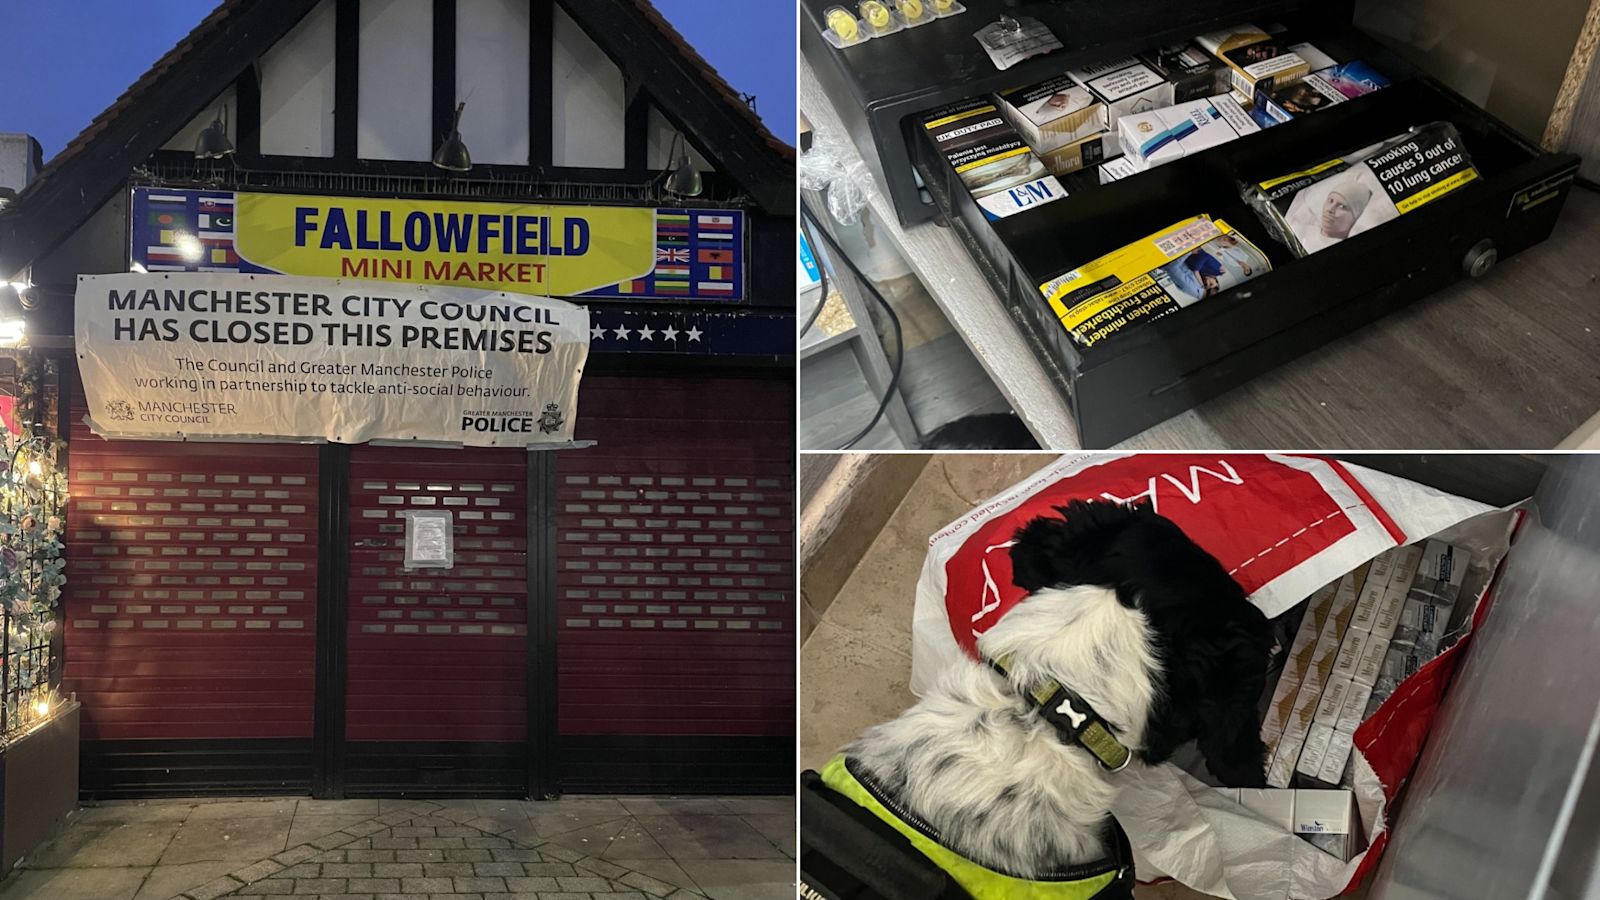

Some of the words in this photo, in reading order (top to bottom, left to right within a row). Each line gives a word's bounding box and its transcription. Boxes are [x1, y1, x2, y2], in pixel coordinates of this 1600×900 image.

[937, 133, 951, 142] UK
[954, 126, 978, 138] DUTY
[980, 118, 1002, 129] PAID
[948, 148, 974, 160] Palenie
[974, 144, 988, 154] jest
[1368, 141, 1420, 170] Smoking
[1379, 158, 1417, 182] causes
[1414, 152, 1425, 164] 9
[1424, 144, 1446, 160] out
[1442, 137, 1457, 152] of
[1008, 180, 1054, 208] L&M
[1387, 180, 1404, 196] 10
[1404, 169, 1433, 190] lung
[294, 207, 591, 257] FALLOWFIELD
[341, 257, 413, 280] MINI
[424, 260, 547, 284] MARKET
[1127, 292, 1172, 322] Rauchen
[1140, 284, 1163, 302] Ihre
[108, 289, 333, 316] MANCHESTER
[341, 296, 412, 319] CITY
[420, 301, 560, 326] COUNCIL
[114, 318, 180, 342] HAS
[189, 322, 314, 346] CLOSED
[322, 323, 392, 348] THIS
[402, 326, 553, 354] PREMISES
[1084, 314, 1127, 347] mindert
[175, 357, 204, 372] The
[208, 358, 265, 374] Council
[268, 360, 296, 375] and
[300, 361, 357, 376] Greater
[361, 362, 448, 378] Manchester
[452, 366, 494, 380] Police
[135, 376, 198, 394] working
[202, 378, 216, 390] in
[220, 378, 308, 396] partnership
[311, 381, 328, 394] to
[330, 379, 375, 394] tackle
[378, 380, 453, 397] anti-social
[456, 382, 531, 398] behaviour.
[138, 401, 238, 415] MANCHESTER
[140, 414, 163, 422] CITY
[164, 414, 211, 424] COUNCIL
[462, 416, 533, 432] POLICE
[1357, 590, 1379, 624] Marlboro
[1378, 596, 1400, 630] Marlboro
[1340, 636, 1362, 670] Marlboro
[1361, 643, 1383, 677] Marlboro
[1321, 683, 1344, 718] Marlboro
[1300, 824, 1324, 832] Winston
